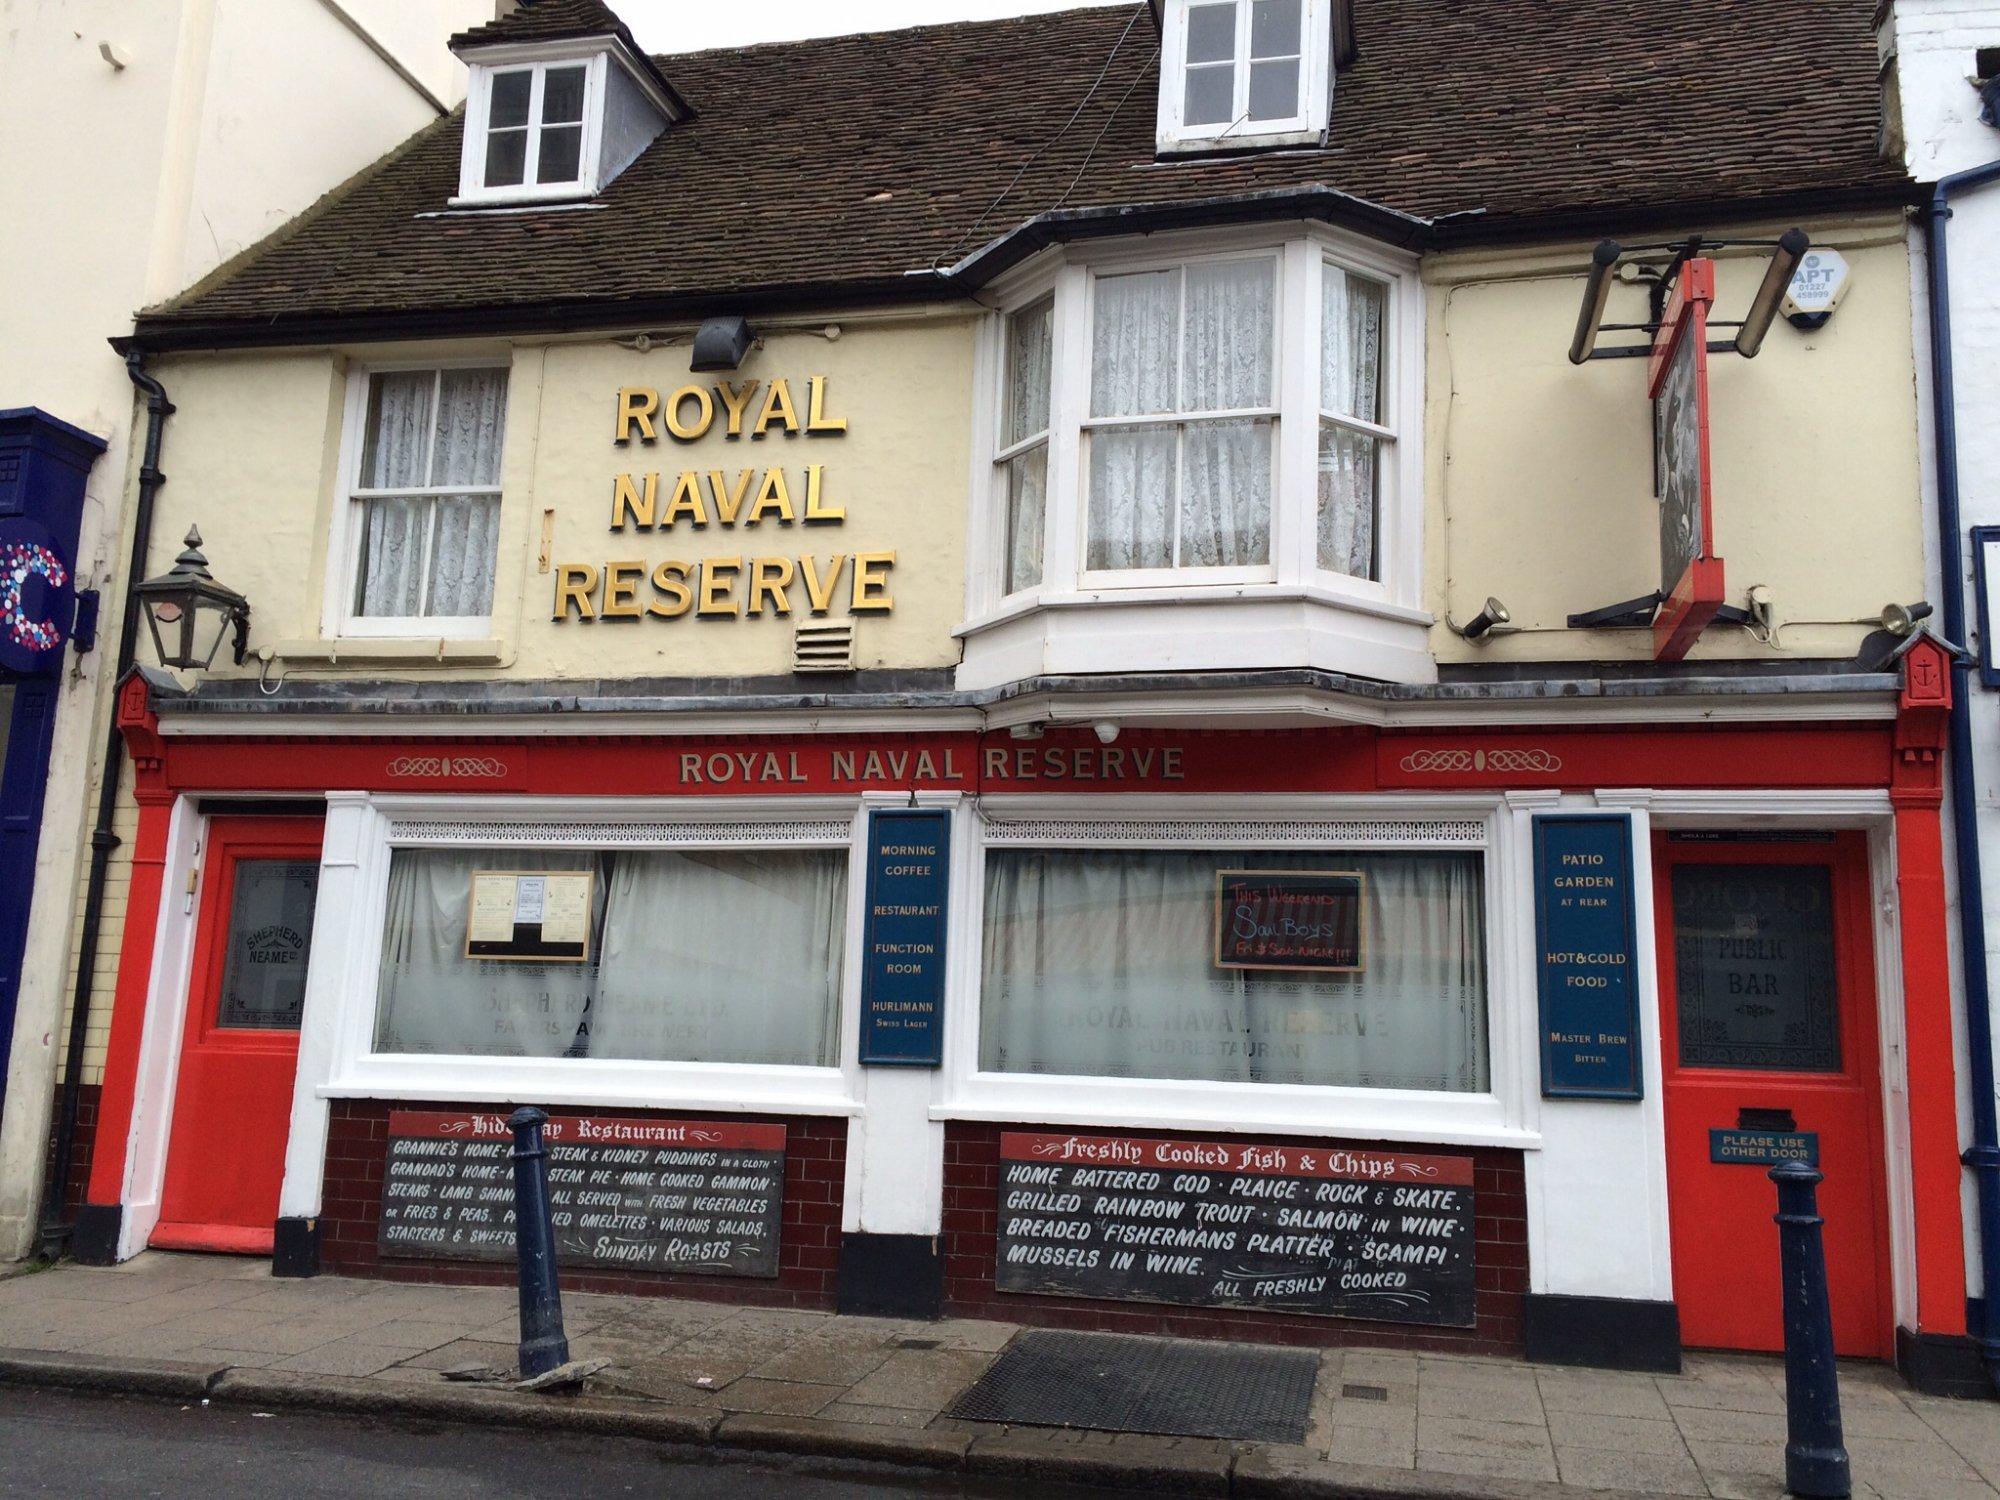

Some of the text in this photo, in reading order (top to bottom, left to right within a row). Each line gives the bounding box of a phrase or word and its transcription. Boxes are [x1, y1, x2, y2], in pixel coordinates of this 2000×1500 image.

[1793, 269, 1834, 283] APT
[614, 376, 848, 443] ROYAL
[610, 465, 847, 529] NAVAL
[553, 550, 896, 621] RESERVE
[680, 747, 1184, 782] ROYAL NAVAL RESERVE
[881, 845, 936, 856] MORNING
[1562, 854, 1603, 865] PATIO
[885, 866, 931, 876] COFFEE
[1554, 876, 1614, 887] GARDEN
[874, 905, 940, 916] RESTAURANT
[246, 926, 303, 950] SHEPHERD
[875, 943, 934, 954] FUNCTION
[1719, 938, 1788, 961] PUBLIC
[249, 951, 288, 963] NEAME
[887, 964, 922, 974] ROOM
[1567, 976, 1607, 987] FOOD
[1728, 973, 1780, 995] BAR
[872, 1002, 933, 1012] HURLIMANN
[578, 1119, 686, 1142] Restaurant
[1723, 1136, 1805, 1148] PLEASE USE
[393, 1140, 460, 1157] GRANNIE'S
[551, 1147, 589, 1162] STEAK
[590, 1151, 599, 1160] &
[601, 1149, 649, 1164] KIDNEY
[654, 1150, 717, 1166] PUDDINGS
[720, 1159, 730, 1167] IN
[742, 1159, 770, 1169] CLOTH
[1060, 1137, 1395, 1178] Freshly Cooked Fish & Chips
[1721, 1147, 1808, 1159] OTHER DOOR
[390, 1162, 456, 1178] GRANDAD'S
[548, 1168, 585, 1183] STEAK
[590, 1170, 613, 1184] PIE
[620, 1170, 656, 1186] HOME
[660, 1173, 704, 1188] COOKED
[711, 1174, 768, 1191] GAMMON
[1006, 1165, 1062, 1185] HOME
[1071, 1168, 1160, 1191] BATTERED
[1173, 1174, 1211, 1194] COD
[1229, 1178, 1300, 1199] PLAICE
[1315, 1183, 1368, 1204] ROCK
[1374, 1191, 1384, 1205] &
[388, 1182, 431, 1198] STEAKS
[439, 1185, 473, 1200] LAMB
[552, 1190, 571, 1204] ALL
[577, 1191, 621, 1206] SERVED
[649, 1194, 687, 1210] FRESH
[693, 1197, 768, 1214] VEGETABLES
[403, 1205, 438, 1220] FRIES
[444, 1206, 452, 1220] &
[580, 1213, 647, 1230] OMELETTES
[659, 1216, 711, 1233] VARIOUS
[1006, 1191, 1458, 1238] GRILLED RAINBOW TROUT SALMON IN WINE
[387, 1226, 446, 1242] STARTERS
[453, 1229, 461, 1242] &
[1006, 1217, 1091, 1241] BREADED
[1104, 1224, 1237, 1250] FISHERMANS
[1247, 1233, 1334, 1258] PLATTER
[1362, 1242, 1448, 1265] SCAMPI
[593, 1236, 732, 1262] SUNDAY ROASTS
[1006, 1244, 1204, 1276] MUSSELS IN WINE.
[1212, 1272, 1407, 1297] ALL FRESHLY COOKED
